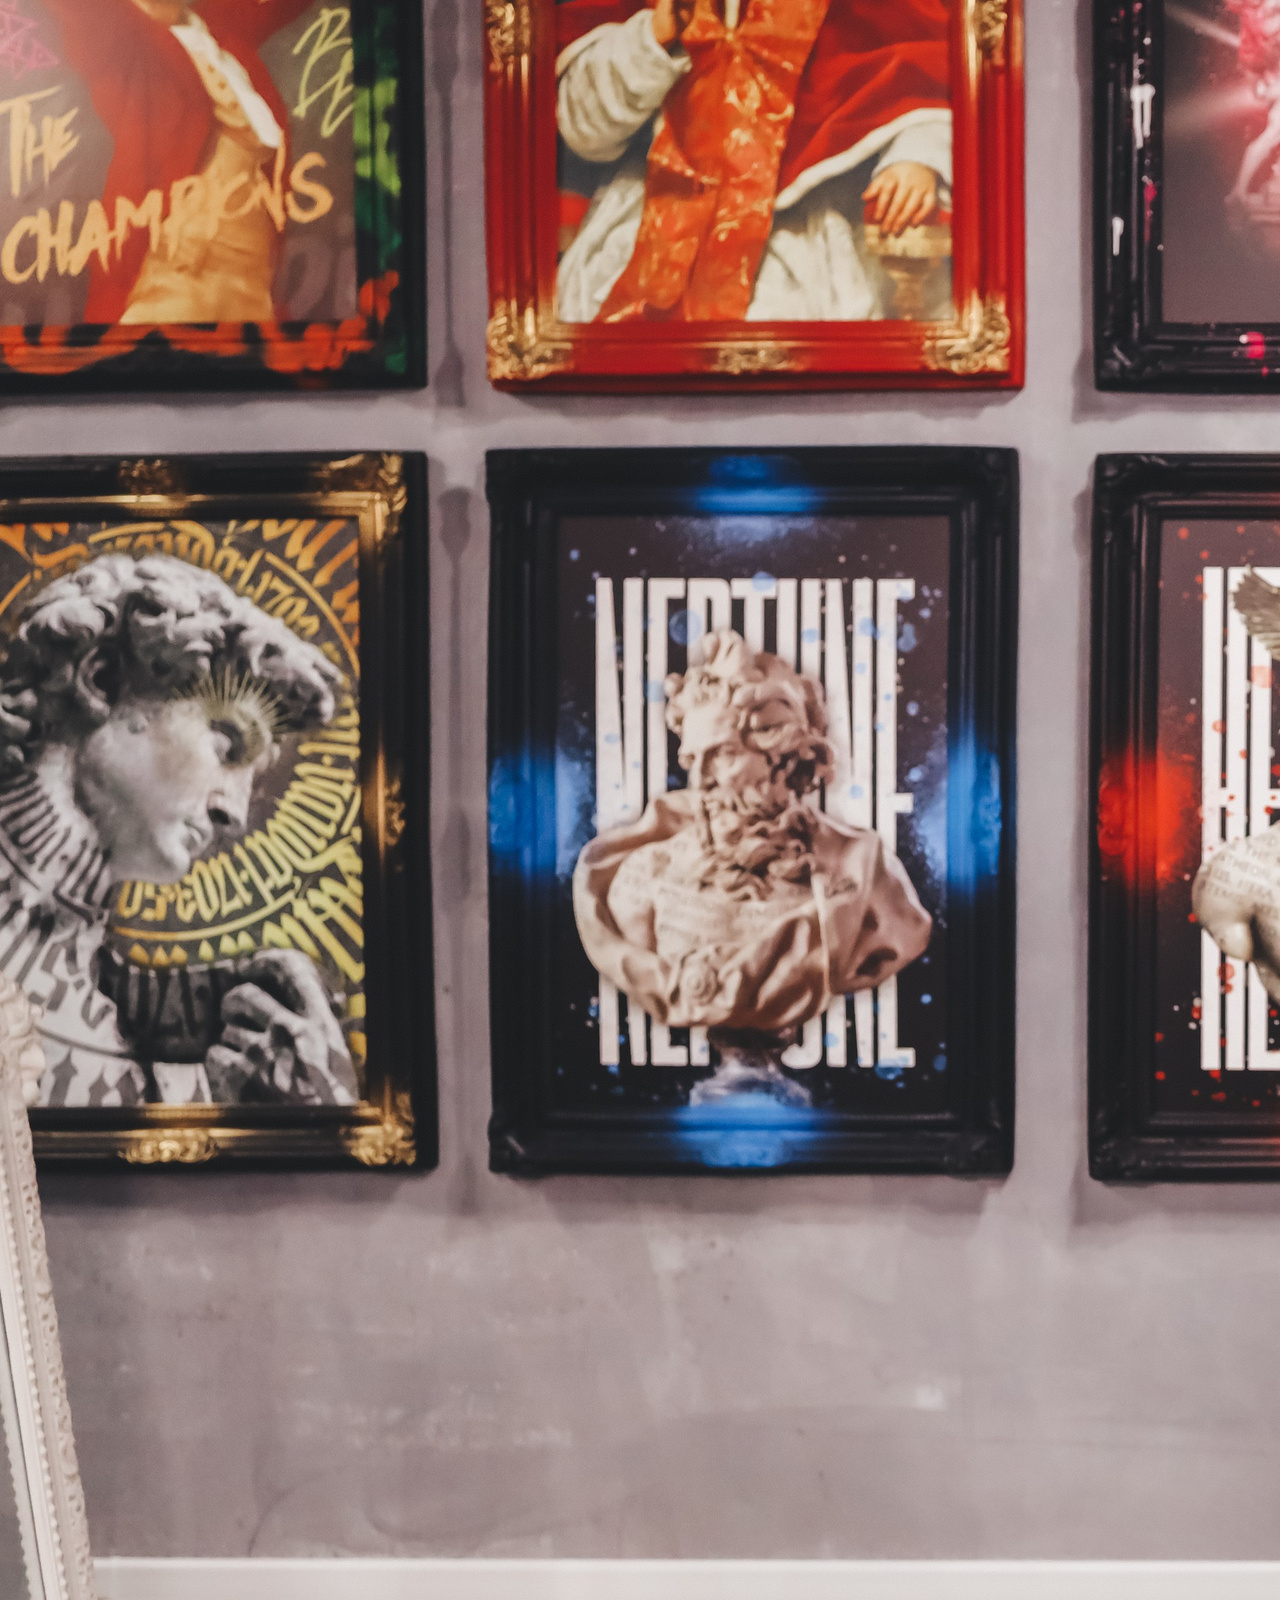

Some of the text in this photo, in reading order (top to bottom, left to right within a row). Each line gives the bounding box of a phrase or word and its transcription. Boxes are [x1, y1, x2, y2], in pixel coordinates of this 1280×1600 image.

[0, 85, 80, 197] THE
[1, 130, 333, 284] CHAMPIONS
[595, 576, 916, 1068] NENE
